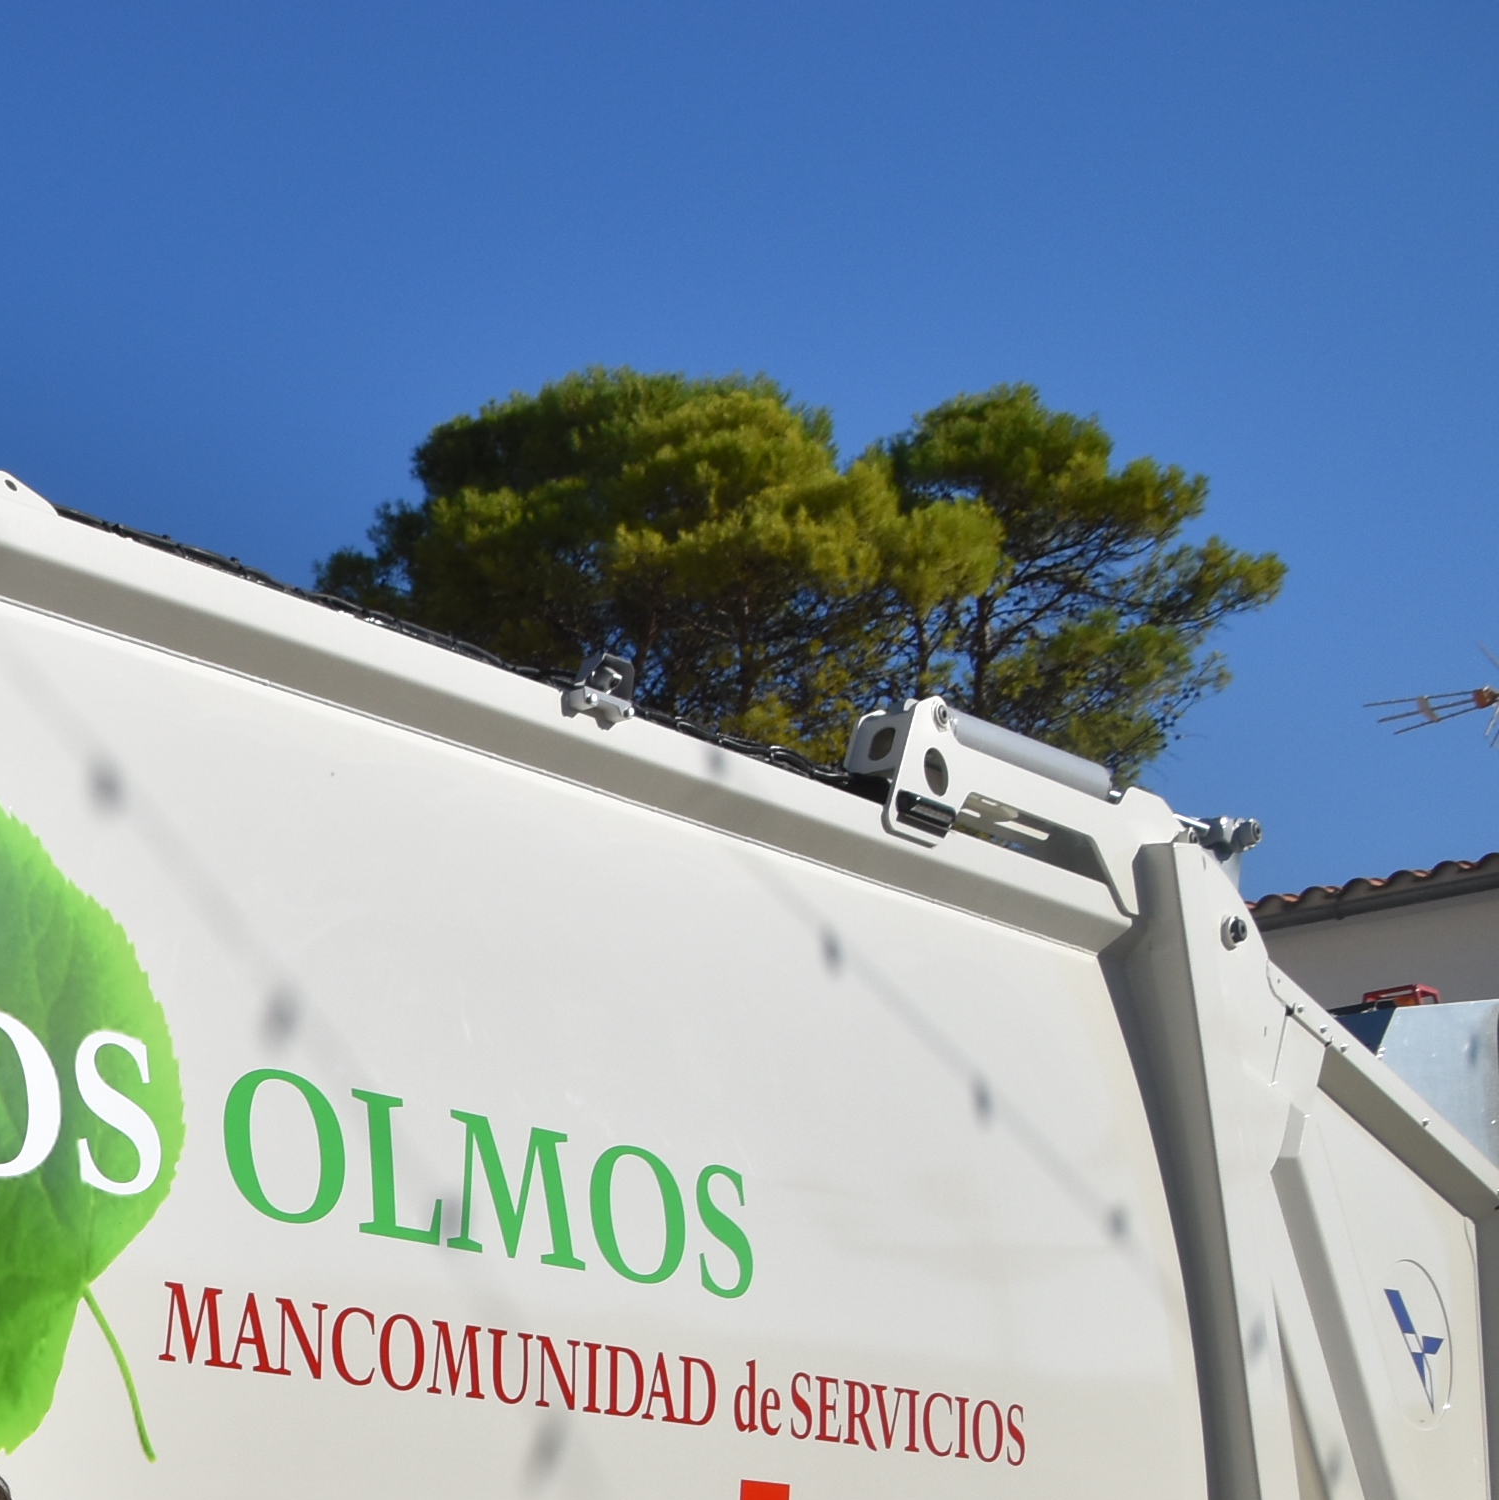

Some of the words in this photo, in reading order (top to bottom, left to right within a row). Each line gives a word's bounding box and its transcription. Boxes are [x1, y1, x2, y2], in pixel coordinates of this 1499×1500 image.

[223, 1068, 754, 1299] OLMOS
[159, 1281, 716, 1427] MANCOMUNIDAD
[733, 1361, 781, 1436] de
[790, 1371, 1026, 1468] SERVICIOS
